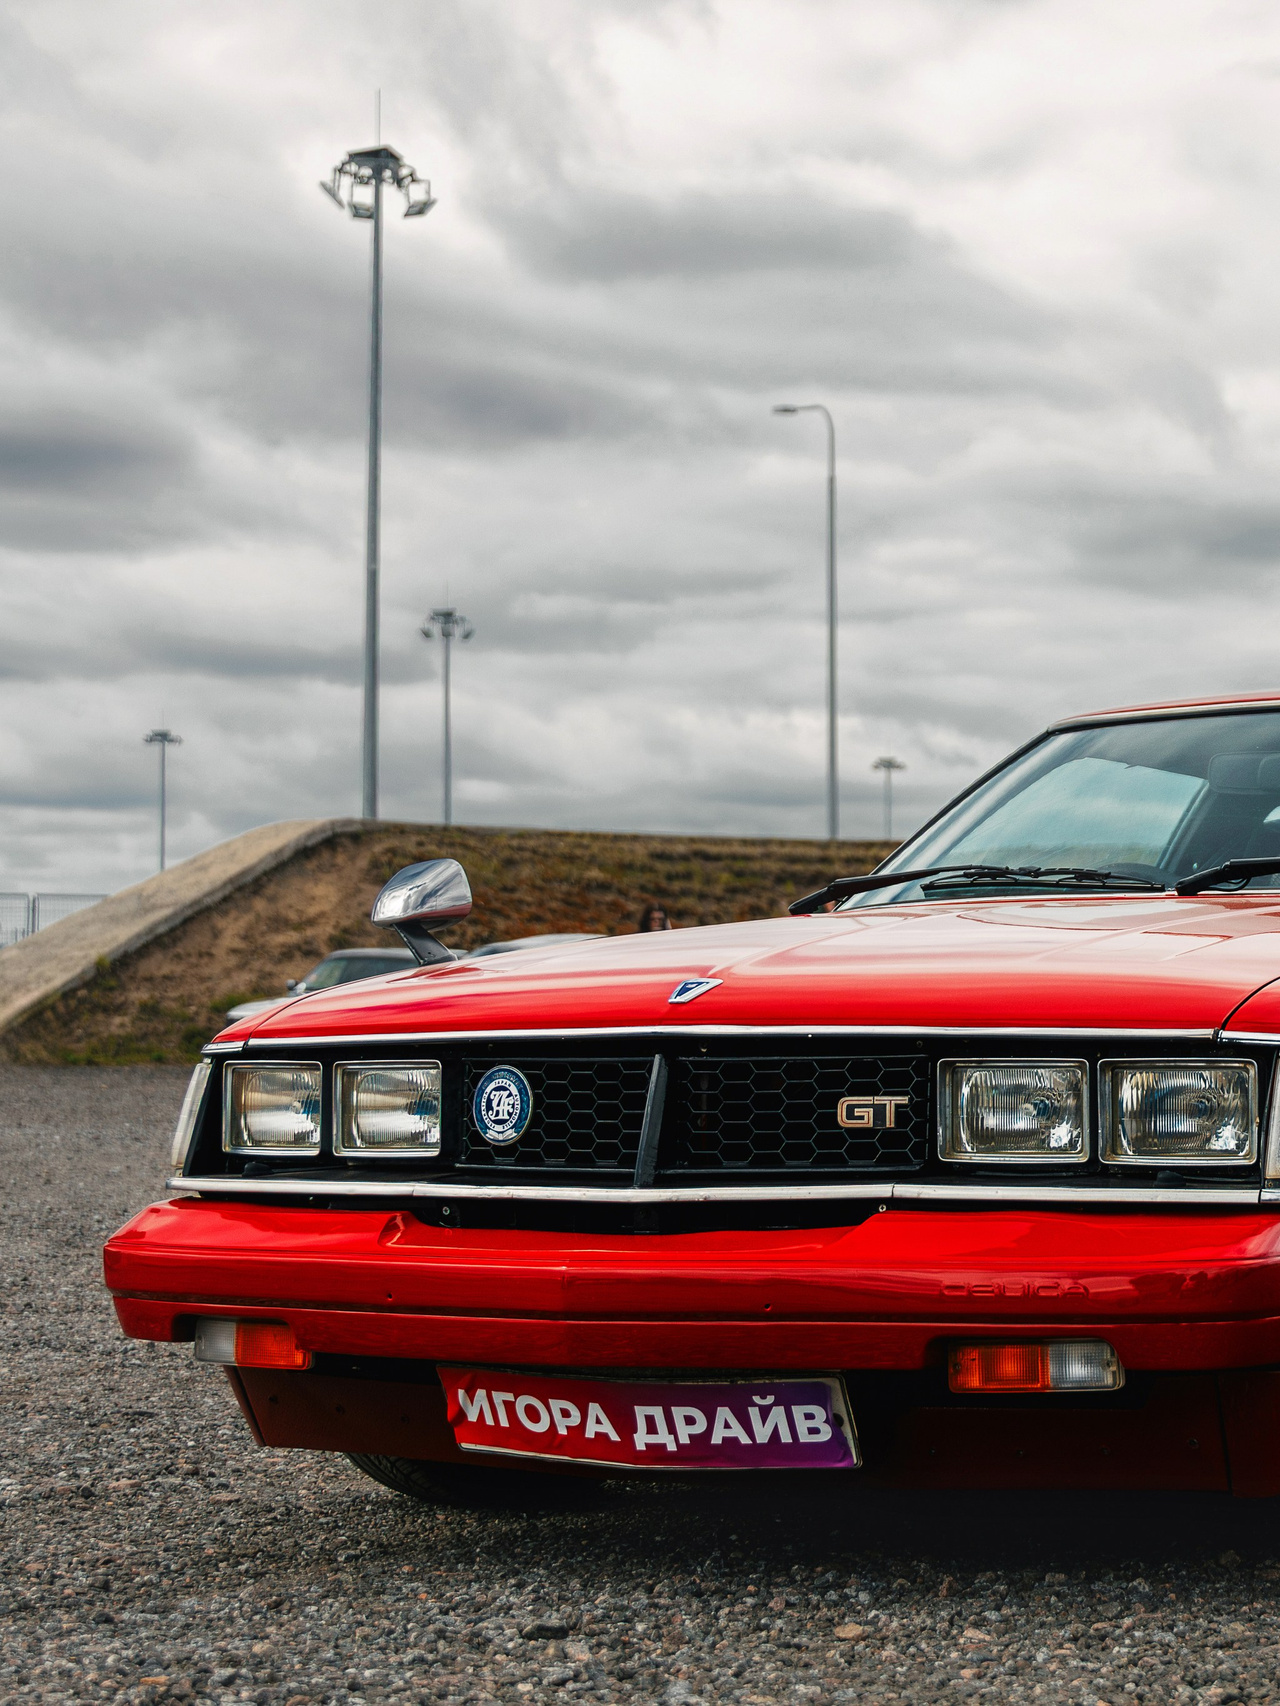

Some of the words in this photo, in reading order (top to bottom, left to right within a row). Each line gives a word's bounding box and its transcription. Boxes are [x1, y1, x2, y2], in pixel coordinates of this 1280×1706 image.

[494, 1080, 512, 1088] JAPAN
[837, 1096, 909, 1128] GT
[457, 1388, 622, 1442] ИГОРА
[633, 1395, 833, 1451] ДРАЙВ
